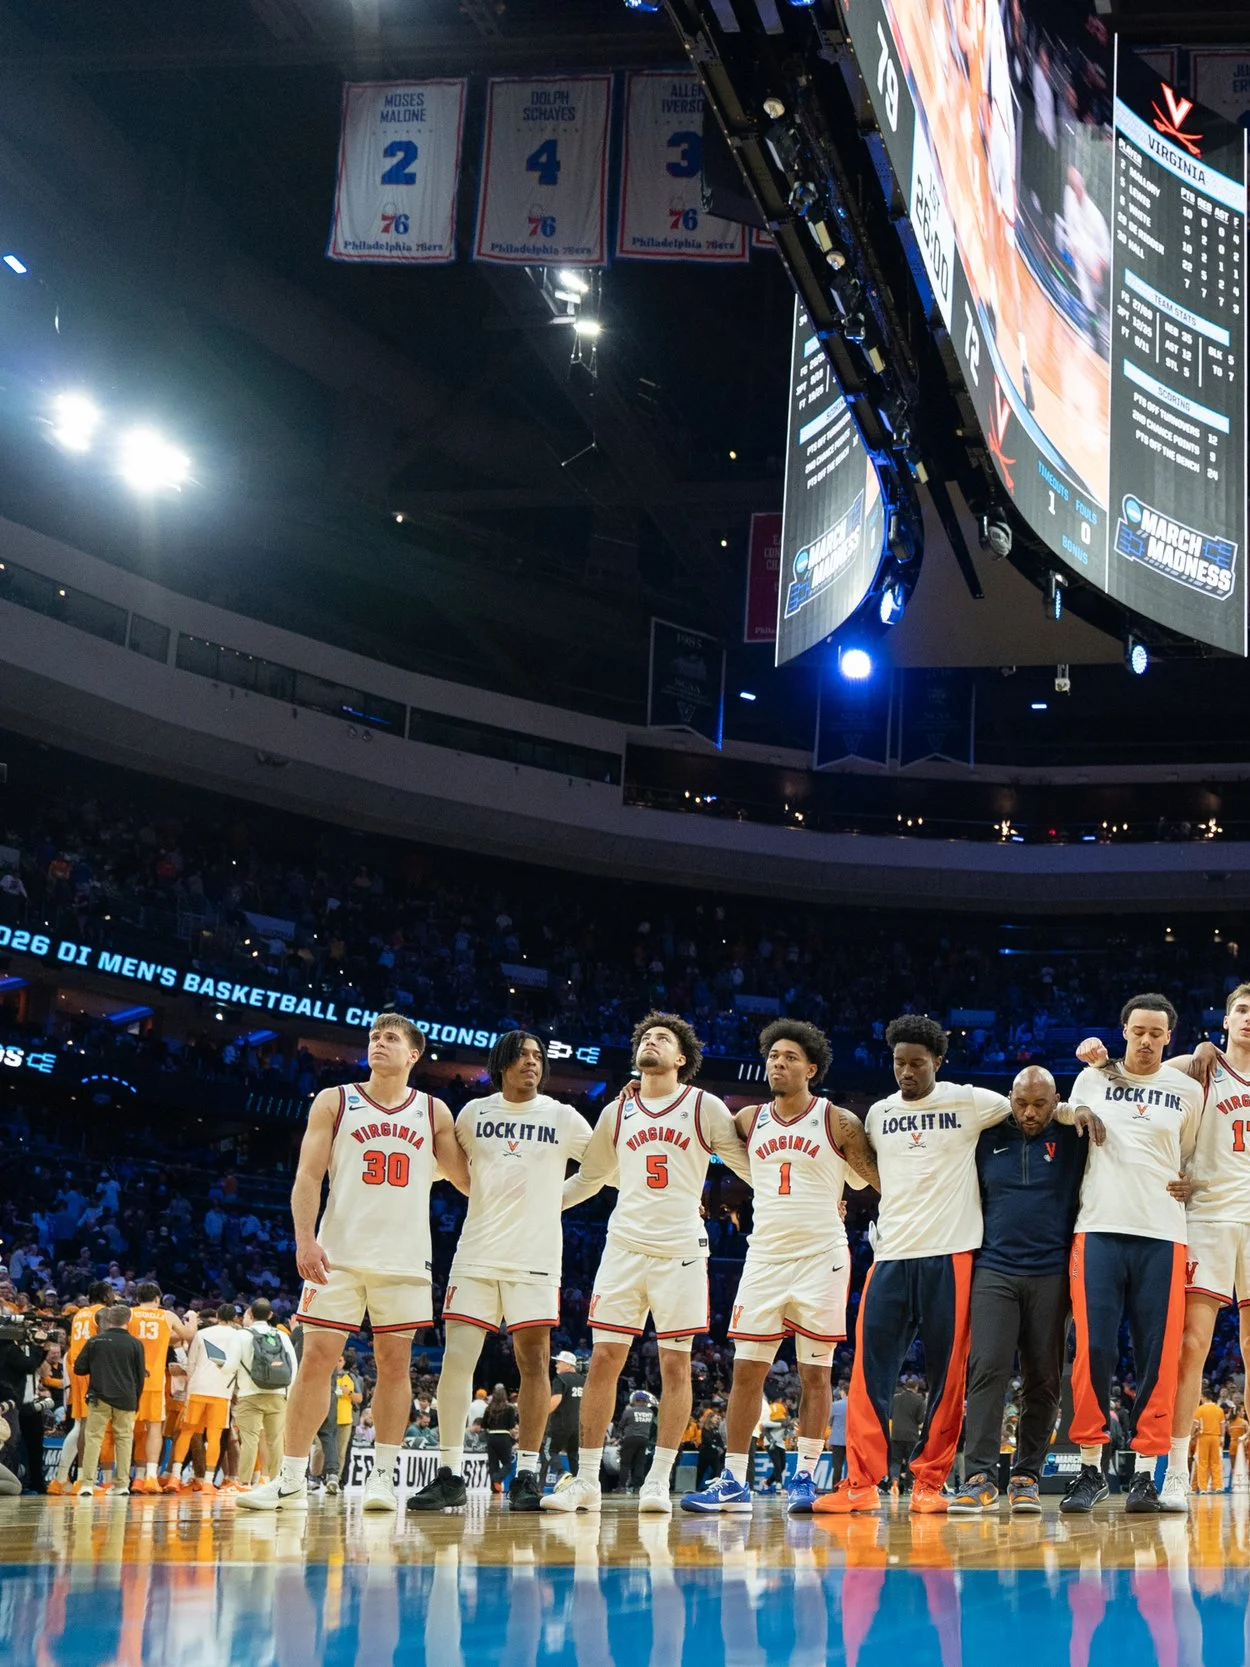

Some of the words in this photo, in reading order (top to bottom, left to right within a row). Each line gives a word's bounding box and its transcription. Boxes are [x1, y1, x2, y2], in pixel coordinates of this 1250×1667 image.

[384, 92, 425, 108] MOSES
[530, 91, 569, 106] DOLPH
[380, 108, 426, 123] MALONE
[523, 106, 576, 121] SCHAYES
[380, 140, 418, 185] 2
[525, 139, 561, 186] 4
[666, 131, 703, 178] 3
[1147, 133, 1206, 186] VIRGINIA
[1118, 138, 1143, 166] PLAYER
[1181, 187, 1196, 204] PTS
[1197, 197, 1213, 214] REB
[1214, 207, 1229, 223] AST
[1129, 166, 1160, 198] MALLORY
[381, 213, 410, 234] 76
[528, 216, 556, 237] 76
[669, 208, 698, 231] 76
[1128, 202, 1152, 228] WHITE
[344, 240, 412, 252] Philadelphia
[491, 242, 557, 255] Philadelphia
[632, 237, 701, 250] Philadelphia
[706, 239, 735, 250] 76ers
[1128, 239, 1145, 260] HALL
[1153, 294, 1174, 312] TEAM
[1174, 307, 1197, 327] STATS
[1164, 340, 1179, 355] AST
[1208, 346, 1223, 361] BLK
[1165, 357, 1179, 373] STL
[1158, 387, 1191, 413] SCORING
[1133, 392, 1147, 409] PTS
[1147, 400, 1160, 415] OFF
[1159, 407, 1201, 438] TURNOVERS
[1208, 433, 1218, 446] 12
[1146, 418, 1173, 441] CHANCE
[1172, 434, 1200, 456] POINTS
[1135, 429, 1149, 446] PTS
[1149, 438, 1162, 452] OFF
[1162, 445, 1176, 461] THE
[1175, 453, 1200, 473] BENCH
[1038, 459, 1069, 502] TIMEOUTS
[1048, 489, 1056, 515] 1
[1075, 499, 1098, 526] FOULS
[1081, 521, 1091, 545] 0
[1140, 509, 1202, 558] MARCH
[1062, 533, 1089, 565] BONUS
[1147, 539, 1231, 592] MADNESS
[57, 941, 93, 966] DI
[97, 951, 178, 987] MEN'S
[183, 972, 339, 1022] BASKETBALL
[1105, 1085, 1147, 1104] LOCK
[1149, 1087, 1163, 1106] IT
[1163, 1091, 1183, 1112] IN.
[351, 1122, 425, 1151] VIRGINIA
[475, 1122, 517, 1139] LOCK
[519, 1122, 536, 1140] IT
[537, 1125, 559, 1145] IN.
[882, 1115, 917, 1135] LOCK
[919, 1114, 938, 1131] IT
[938, 1112, 962, 1131] IN.
[626, 1126, 691, 1152] VIRGINIA
[755, 1136, 821, 1160] VIRGINIA
[362, 1149, 411, 1188] 30
[646, 1154, 668, 1190] 5
[778, 1162, 792, 1196] 1
[73, 1320, 91, 1340] 34
[140, 1321, 159, 1340] 13
